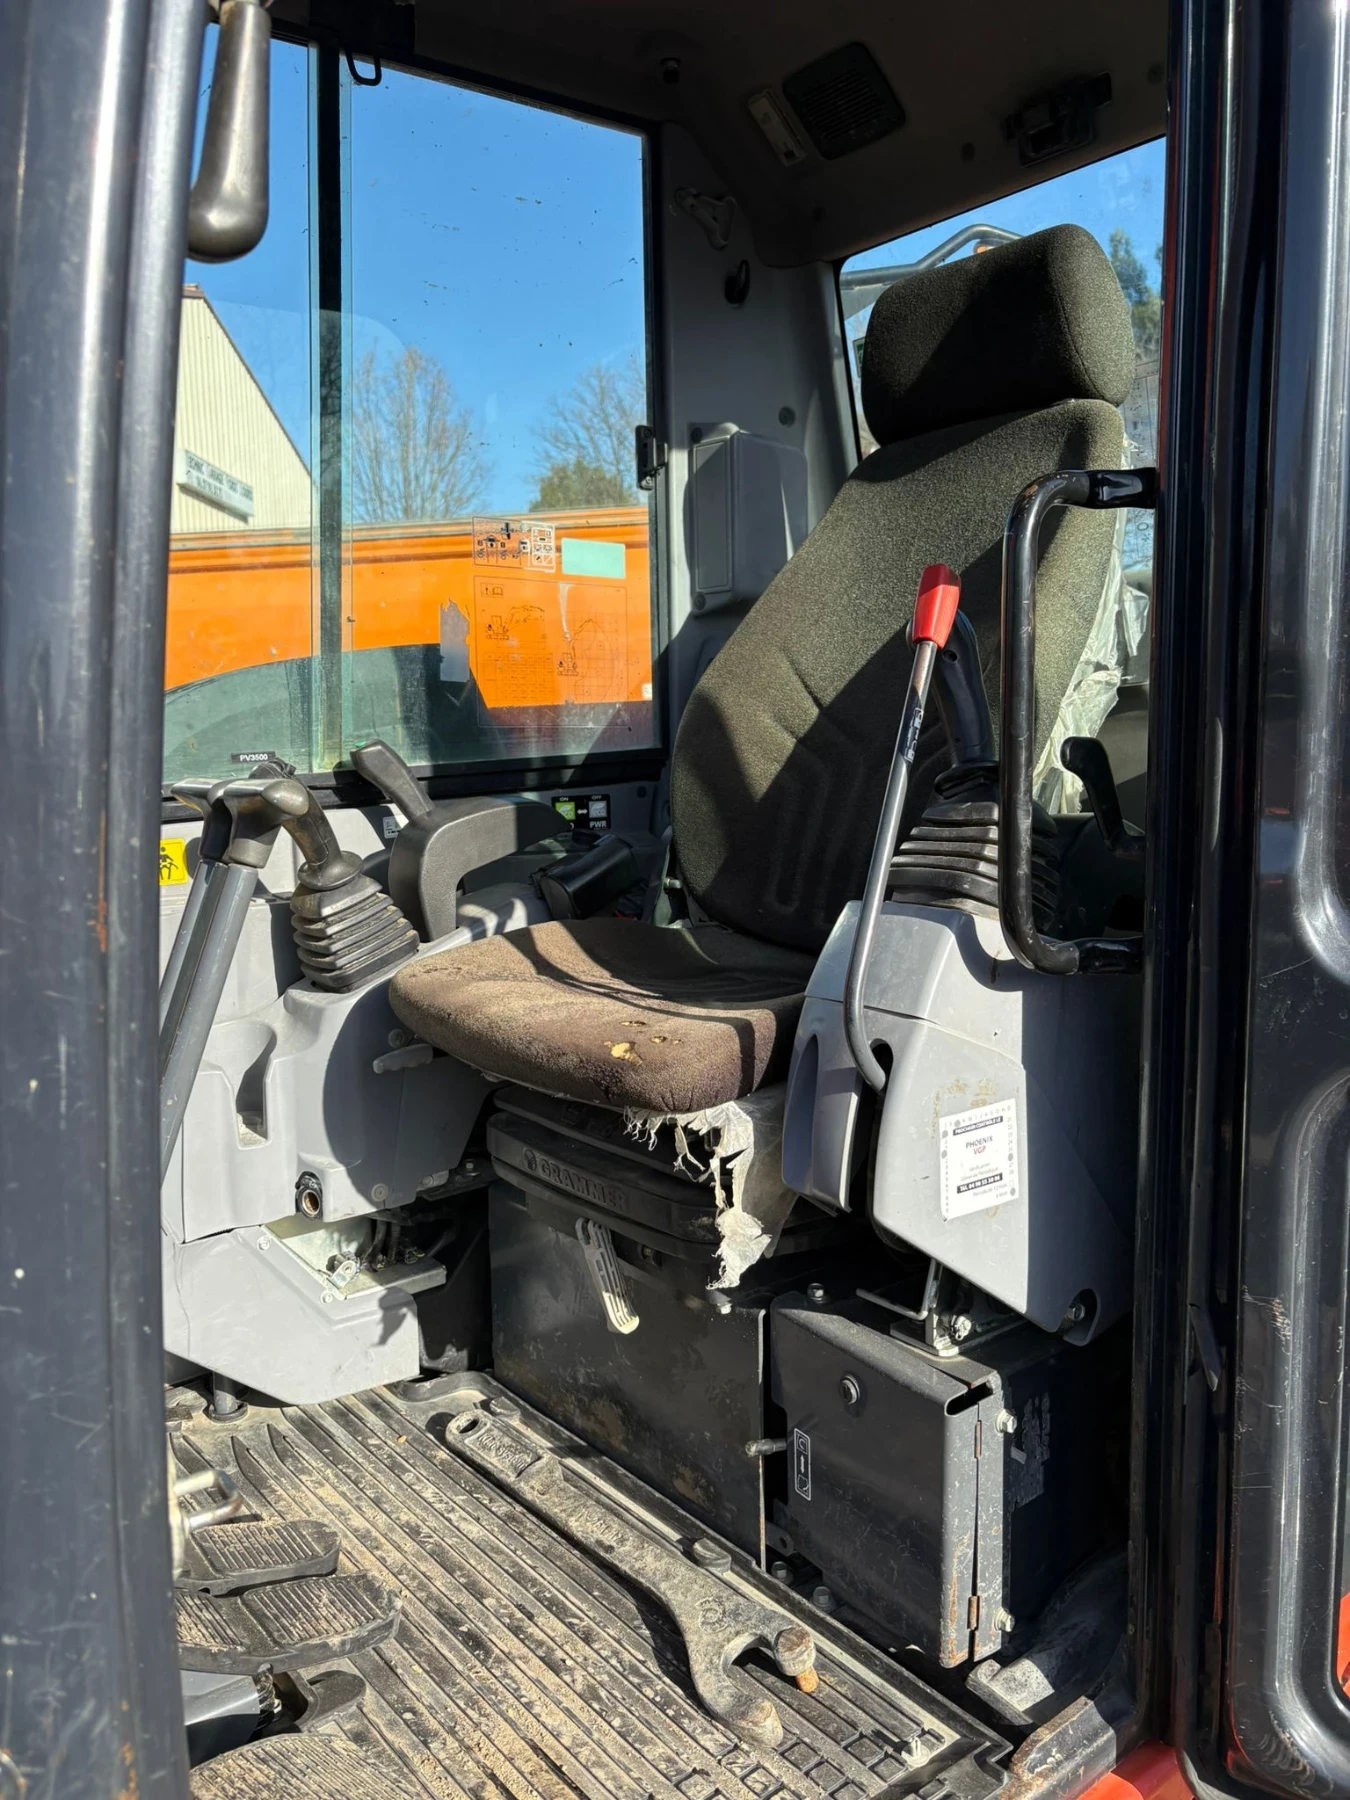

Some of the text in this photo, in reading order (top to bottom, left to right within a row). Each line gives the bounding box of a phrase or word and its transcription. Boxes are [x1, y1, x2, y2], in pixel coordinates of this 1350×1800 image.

[240, 753, 268, 762] PV3500
[590, 820, 607, 829] PWR
[966, 1135, 993, 1149] PHOENIX
[973, 1145, 986, 1155] VGP
[539, 1156, 627, 1210] GRAMMER
